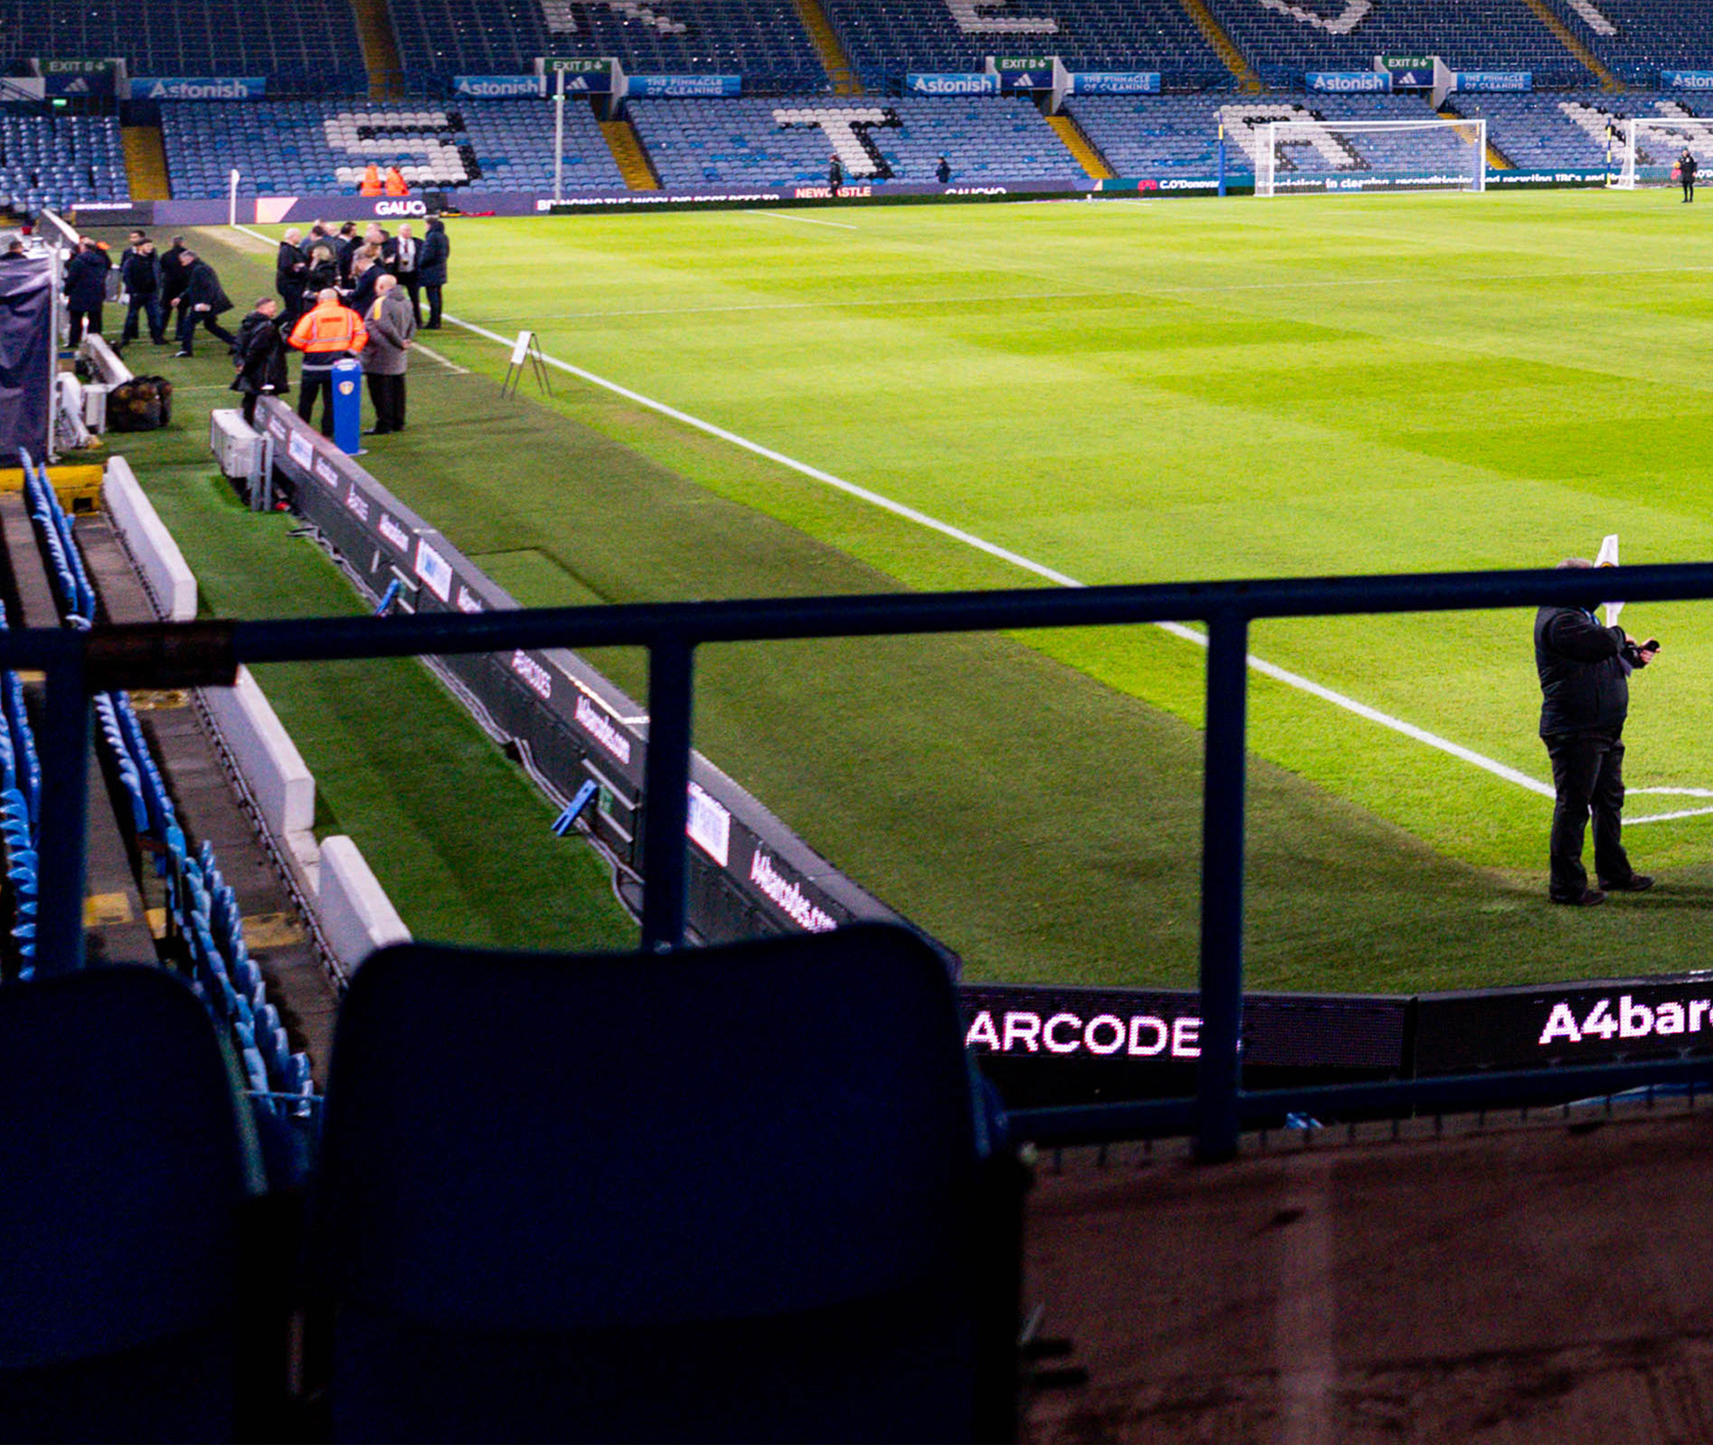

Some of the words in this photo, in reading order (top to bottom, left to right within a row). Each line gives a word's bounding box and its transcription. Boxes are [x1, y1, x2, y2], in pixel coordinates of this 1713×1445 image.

[50, 61, 81, 71] EXIT
[553, 61, 580, 70] EXIT
[1002, 59, 1028, 68] EXIT
[1388, 59, 1411, 67] EXIT
[150, 80, 248, 99] Astonish
[455, 77, 538, 96] Astonish
[913, 75, 992, 93] Astonish
[1312, 74, 1383, 92] Astonish
[795, 186, 872, 199] NEWCSTLE
[965, 1010, 1204, 1057] ARCODE
